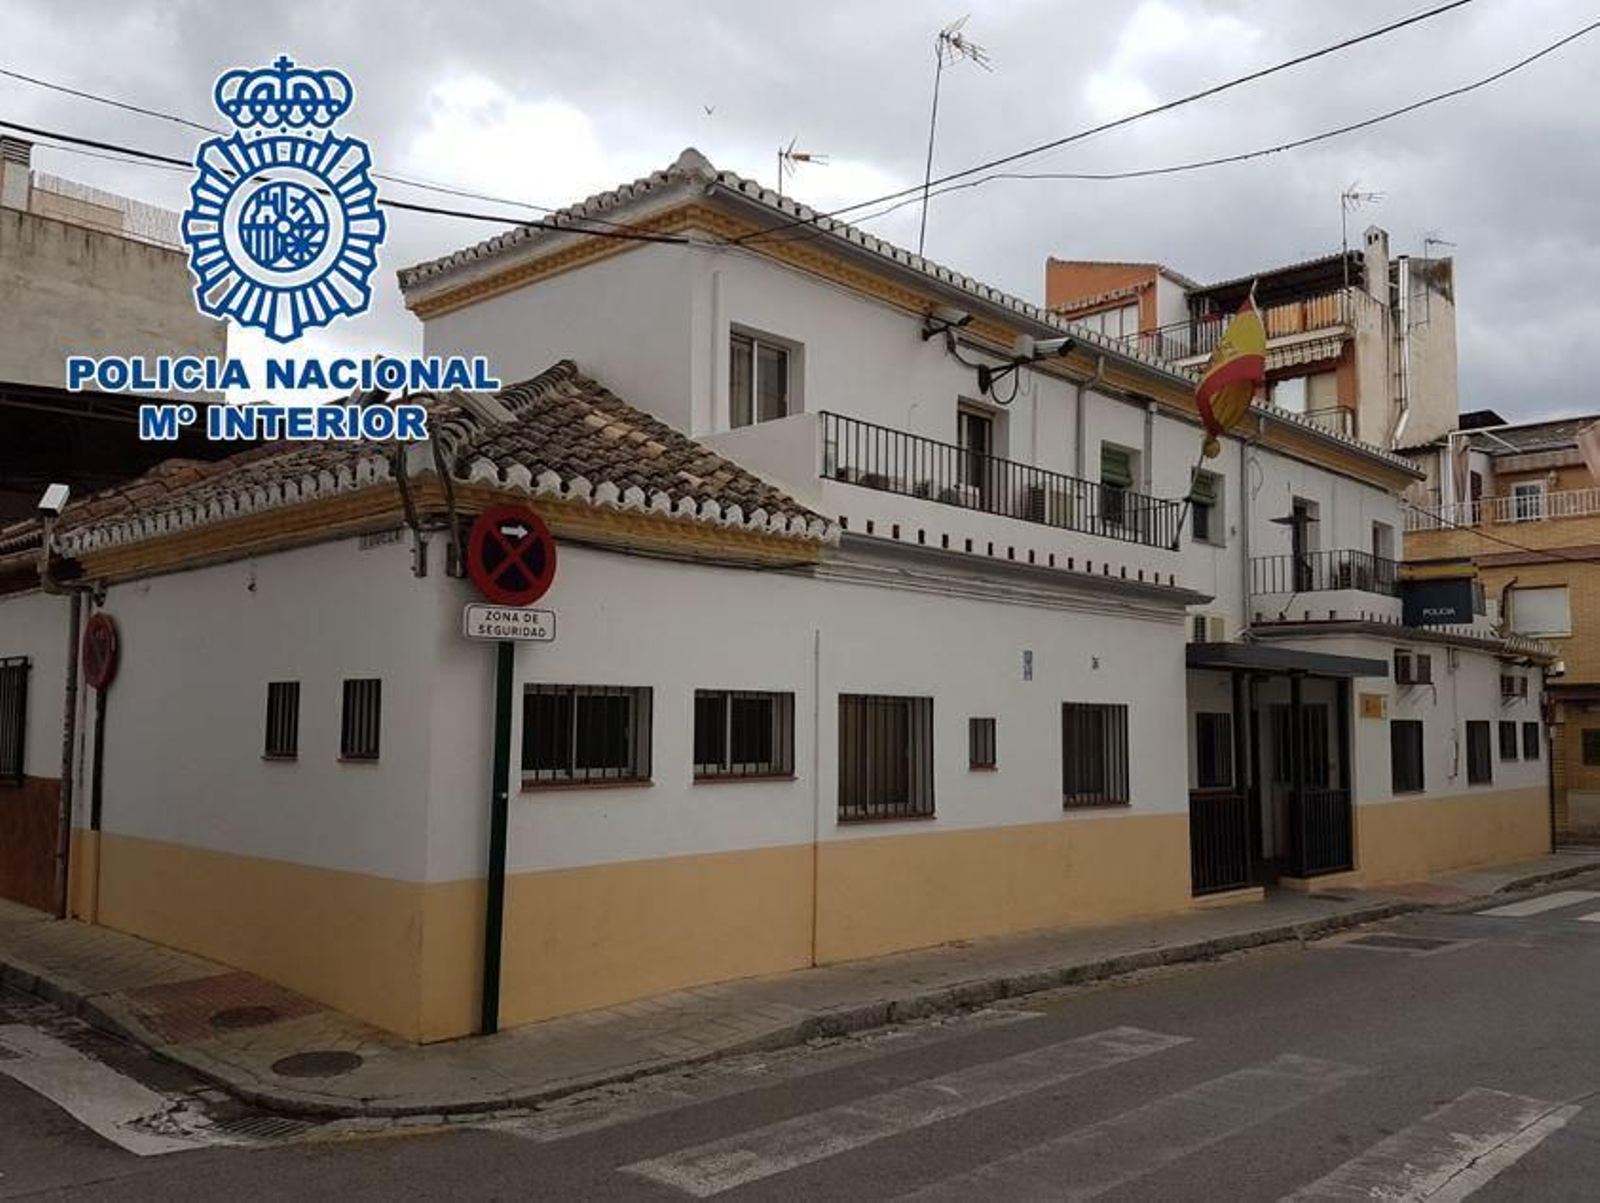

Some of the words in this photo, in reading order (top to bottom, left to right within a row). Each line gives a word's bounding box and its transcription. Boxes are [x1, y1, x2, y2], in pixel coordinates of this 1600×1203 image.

[485, 611, 519, 622] ZONA
[523, 613, 539, 623] DE
[478, 624, 547, 637] SEGURIDAD
